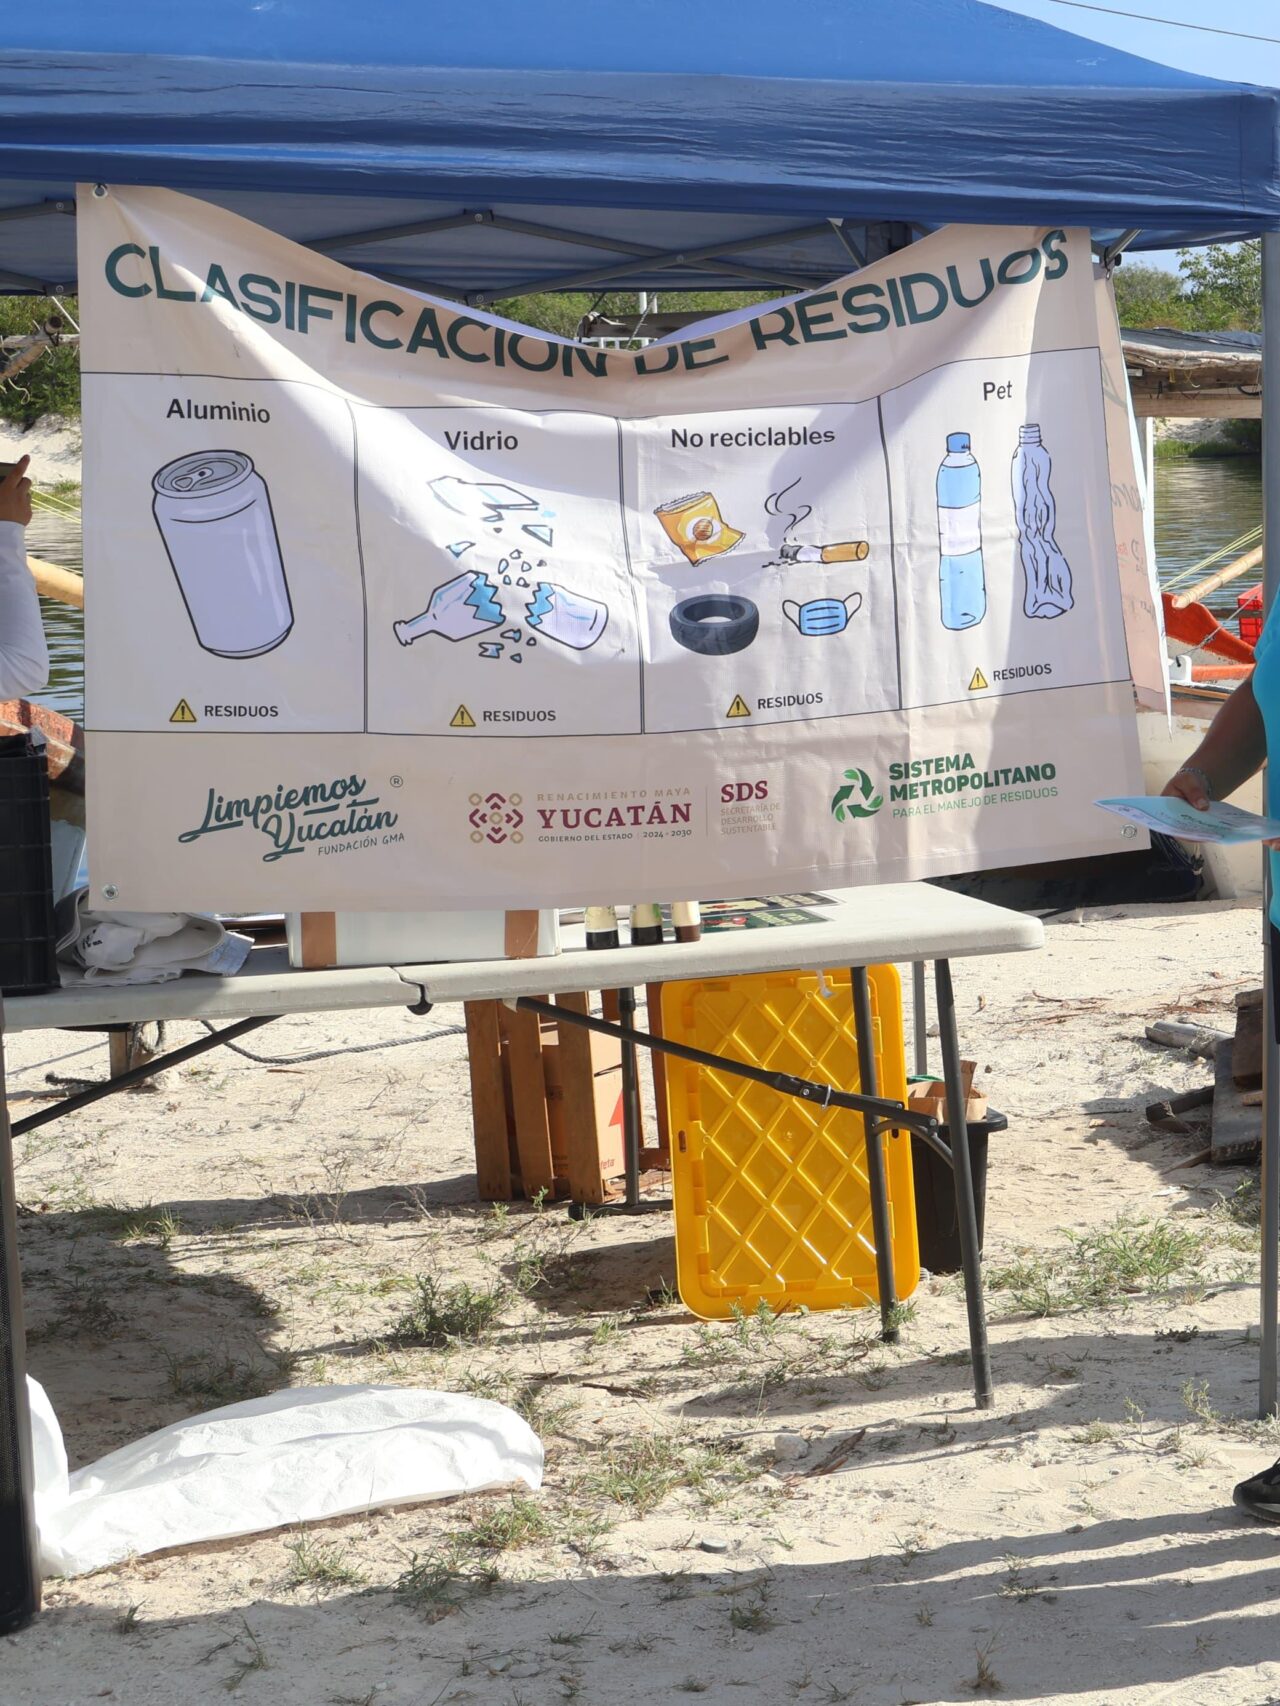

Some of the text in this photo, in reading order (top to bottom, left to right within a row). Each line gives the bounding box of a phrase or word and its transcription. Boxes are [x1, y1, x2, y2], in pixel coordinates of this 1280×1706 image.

[634, 338, 729, 375] DE
[749, 230, 1069, 350] RESIDUOS
[983, 380, 1013, 401] Pet
[167, 399, 270, 423] Aluminio
[444, 430, 519, 450] Vidrio
[671, 426, 835, 448] No reciclables
[993, 662, 1052, 682] RESIDUOS
[204, 705, 279, 718] RESIDUOS
[757, 692, 823, 711] RESIDUOS
[482, 709, 557, 723] RESIDUOS
[889, 753, 975, 781] SISTEMA
[537, 786, 691, 802] RENACIMIENTO MAYA
[720, 780, 769, 804] SDS
[889, 763, 1056, 802] METROPOLITANO
[178, 774, 367, 843] Limpiemos
[769, 802, 780, 812] DE
[892, 786, 1059, 819] PARA EL MANEJO DE RESIDUOS
[537, 801, 693, 829] YUCATÁN
[262, 797, 399, 863] Yucatán
[538, 833, 582, 842] GOBIERNO
[584, 833, 601, 841] DEL
[602, 832, 633, 841] ESTADO
[643, 830, 664, 838] 2024
[671, 829, 692, 838] 2030
[318, 832, 405, 856] FUNDACIÓN GMA
